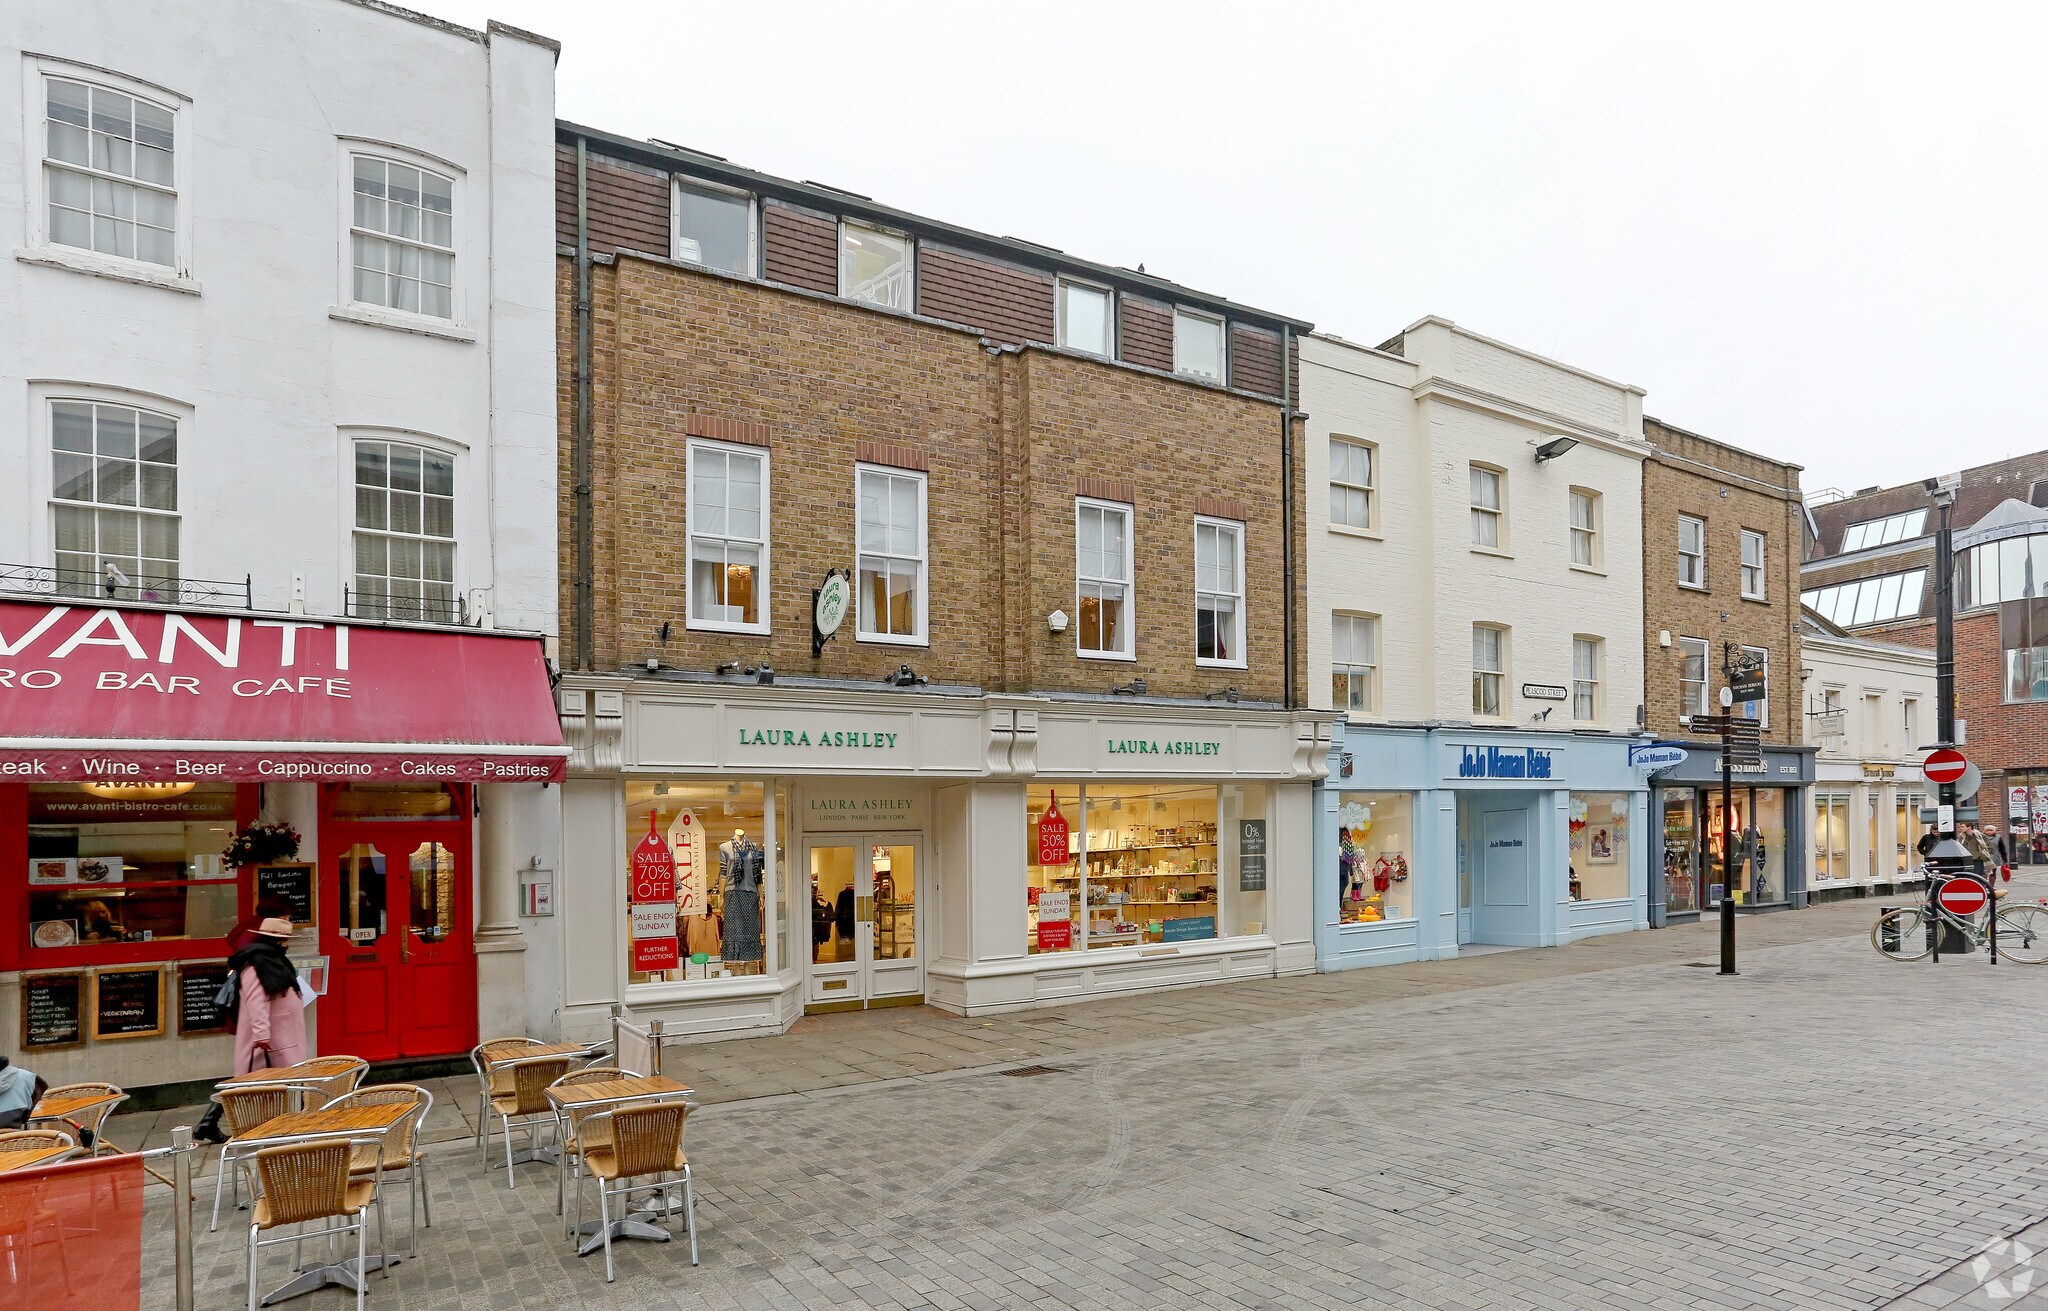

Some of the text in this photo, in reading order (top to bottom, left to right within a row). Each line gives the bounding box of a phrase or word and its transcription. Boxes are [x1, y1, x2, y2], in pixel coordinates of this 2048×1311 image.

[96, 671, 201, 696] BAR
[232, 676, 352, 699] CAFÉ
[1526, 687, 1564, 697] PEASCOD STREET
[739, 728, 898, 748] LAURA ASHLEY
[1108, 739, 1221, 755] LAURA ASHLEY
[1459, 745, 1551, 779] JoJo Maman Bébé
[1637, 752, 1681, 763] JoJo Maman Bébé
[82, 758, 140, 775] Wine
[175, 759, 226, 775] Beer
[257, 759, 373, 778] Cappuccino
[400, 761, 456, 776] Cakes
[483, 761, 549, 777] Pastries
[1789, 766, 1797, 774] 1851
[46, 801, 225, 812] www.avanti-bistro-cafe.co.uk
[811, 800, 913, 810] LAURA ASHLEY
[1041, 824, 1065, 833] SALE
[1245, 823, 1260, 838] 0%
[1042, 834, 1066, 847] 50%
[637, 853, 670, 863] SALE
[1041, 849, 1065, 861] OFF
[639, 865, 671, 880] 70%
[676, 832, 694, 910] SALE
[637, 882, 670, 898] OFF
[633, 912, 674, 921] SALE ENDS
[637, 922, 670, 931] SUNDAY
[355, 931, 372, 939] OPEN
[639, 953, 674, 961] REDUCTIONS
